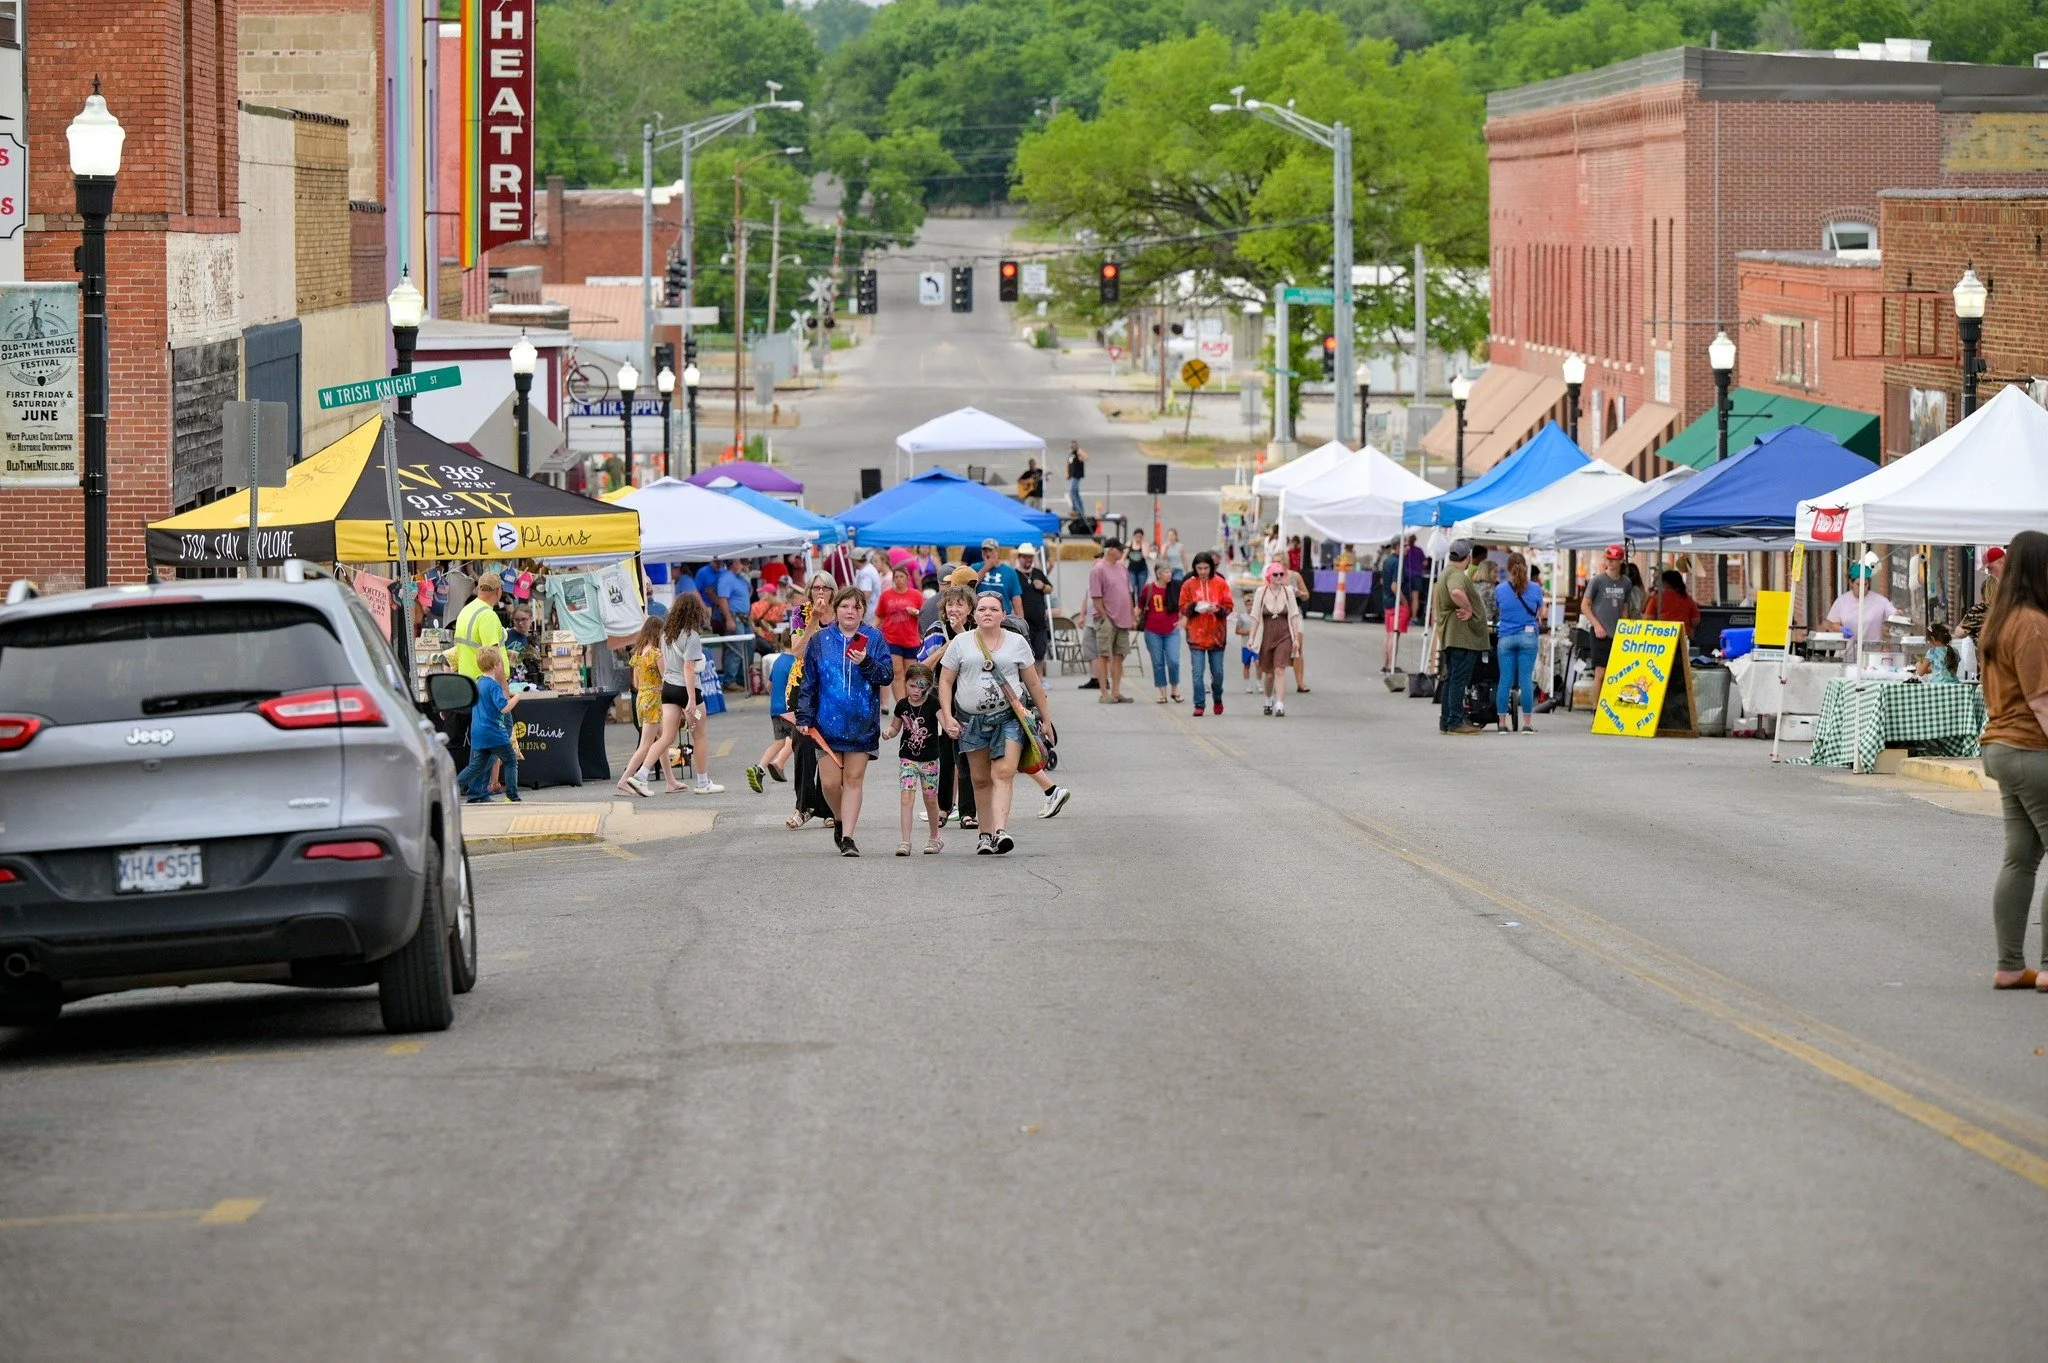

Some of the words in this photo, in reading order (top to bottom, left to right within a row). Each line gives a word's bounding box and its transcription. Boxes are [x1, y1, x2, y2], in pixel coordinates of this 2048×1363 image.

[488, 0, 525, 231] HEATRE
[1, 342, 44, 352] OLD-TIME
[46, 338, 75, 347] MUSIC
[1, 351, 31, 360] OZARK
[33, 346, 77, 356] HERITAGE
[21, 360, 60, 369] FESTIVAL
[66, 391, 74, 399] &
[322, 391, 333, 406] W
[336, 384, 371, 404] TRISH
[375, 376, 417, 398] KNIGHT
[429, 375, 438, 385] ST
[21, 410, 59, 421] JUNE
[6, 432, 20, 441] WEST
[21, 432, 39, 441] PLAINS
[54, 432, 74, 441] CENTER
[17, 443, 41, 451] HISTORIC
[42, 443, 72, 451] DOWNTOWN
[448, 491, 515, 516] W
[247, 530, 297, 559] XPLORE.
[385, 521, 490, 558] EXPLORE
[520, 525, 592, 548] Plains
[1617, 622, 1642, 635] Gulf
[1645, 624, 1678, 637] Fresh
[1622, 639, 1665, 656] Shrimp
[1607, 660, 1640, 685] Oysters
[1646, 659, 1665, 682] Crabs
[1600, 698, 1625, 732] Crawfish
[1637, 712, 1655, 730] Fish
[126, 728, 175, 745] Jeep
[527, 723, 565, 739] Plains
